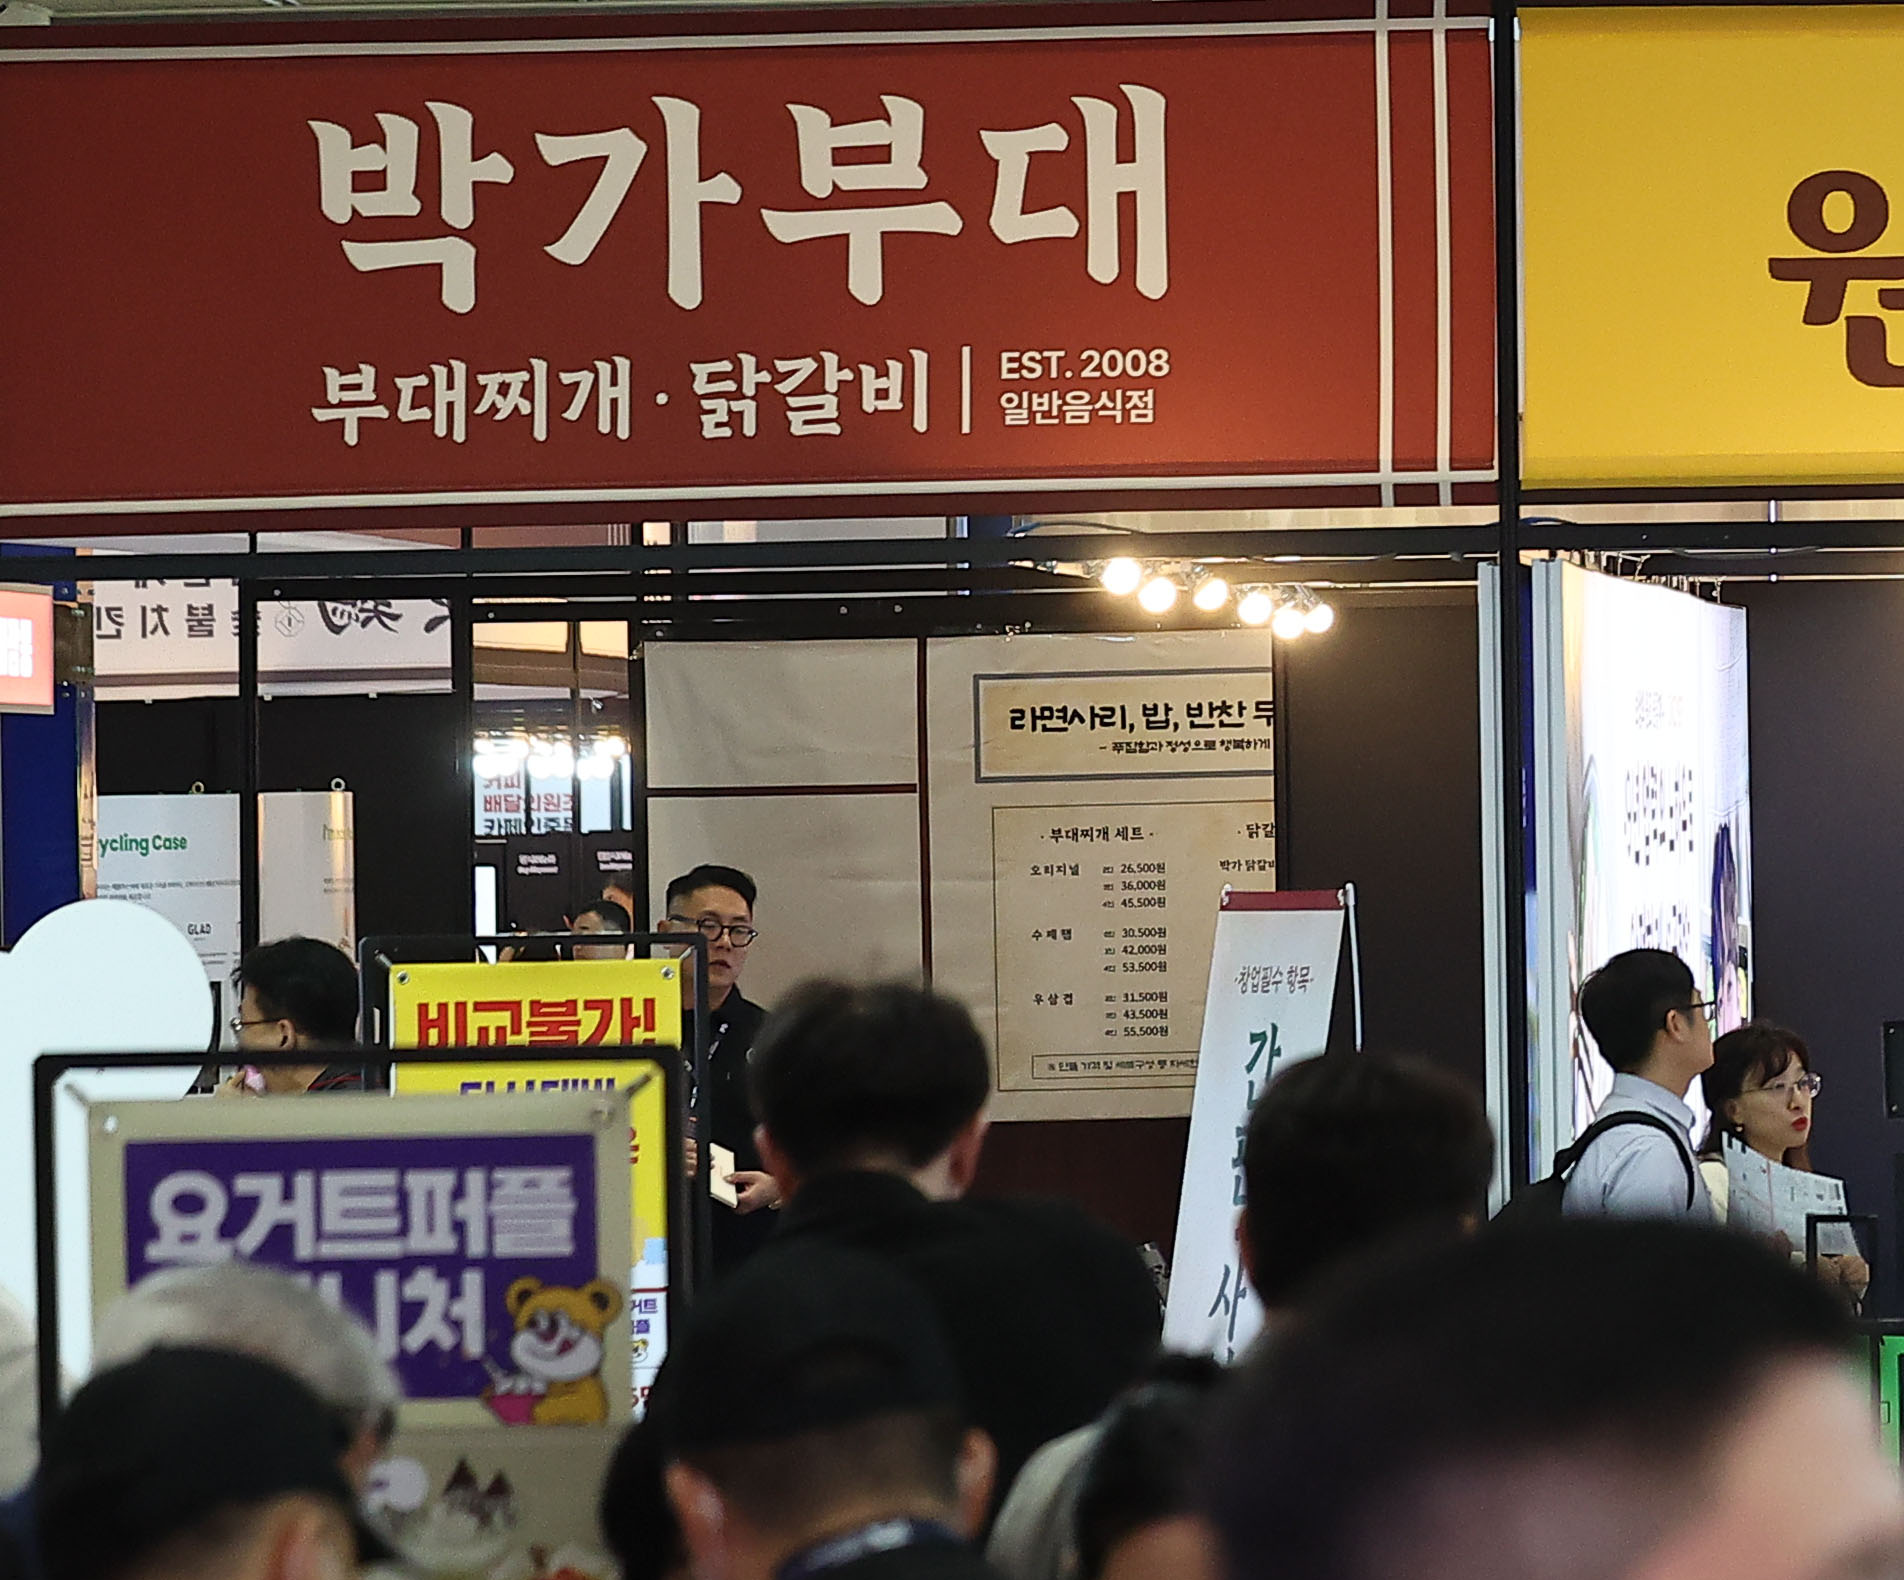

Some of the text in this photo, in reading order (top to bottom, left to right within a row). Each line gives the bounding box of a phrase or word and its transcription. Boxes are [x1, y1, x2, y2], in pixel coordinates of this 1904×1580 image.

[307, 84, 1169, 314] 박가부대
[1000, 349, 1171, 380] EST. 2008
[311, 349, 929, 446] 부대찌개 닭갈비
[1000, 388, 1155, 427] 일반음식점
[1009, 704, 1135, 733] 라면사리,
[1142, 703, 1179, 733] 밥,
[1186, 700, 1247, 729] 반찬
[152, 834, 188, 851] Case
[1050, 826, 1144, 843] 부대찌개 세트
[1239, 965, 1311, 993] 창업필수 항목
[417, 997, 656, 1046] 비교불가!
[144, 1166, 579, 1263] 요거트퍼플
